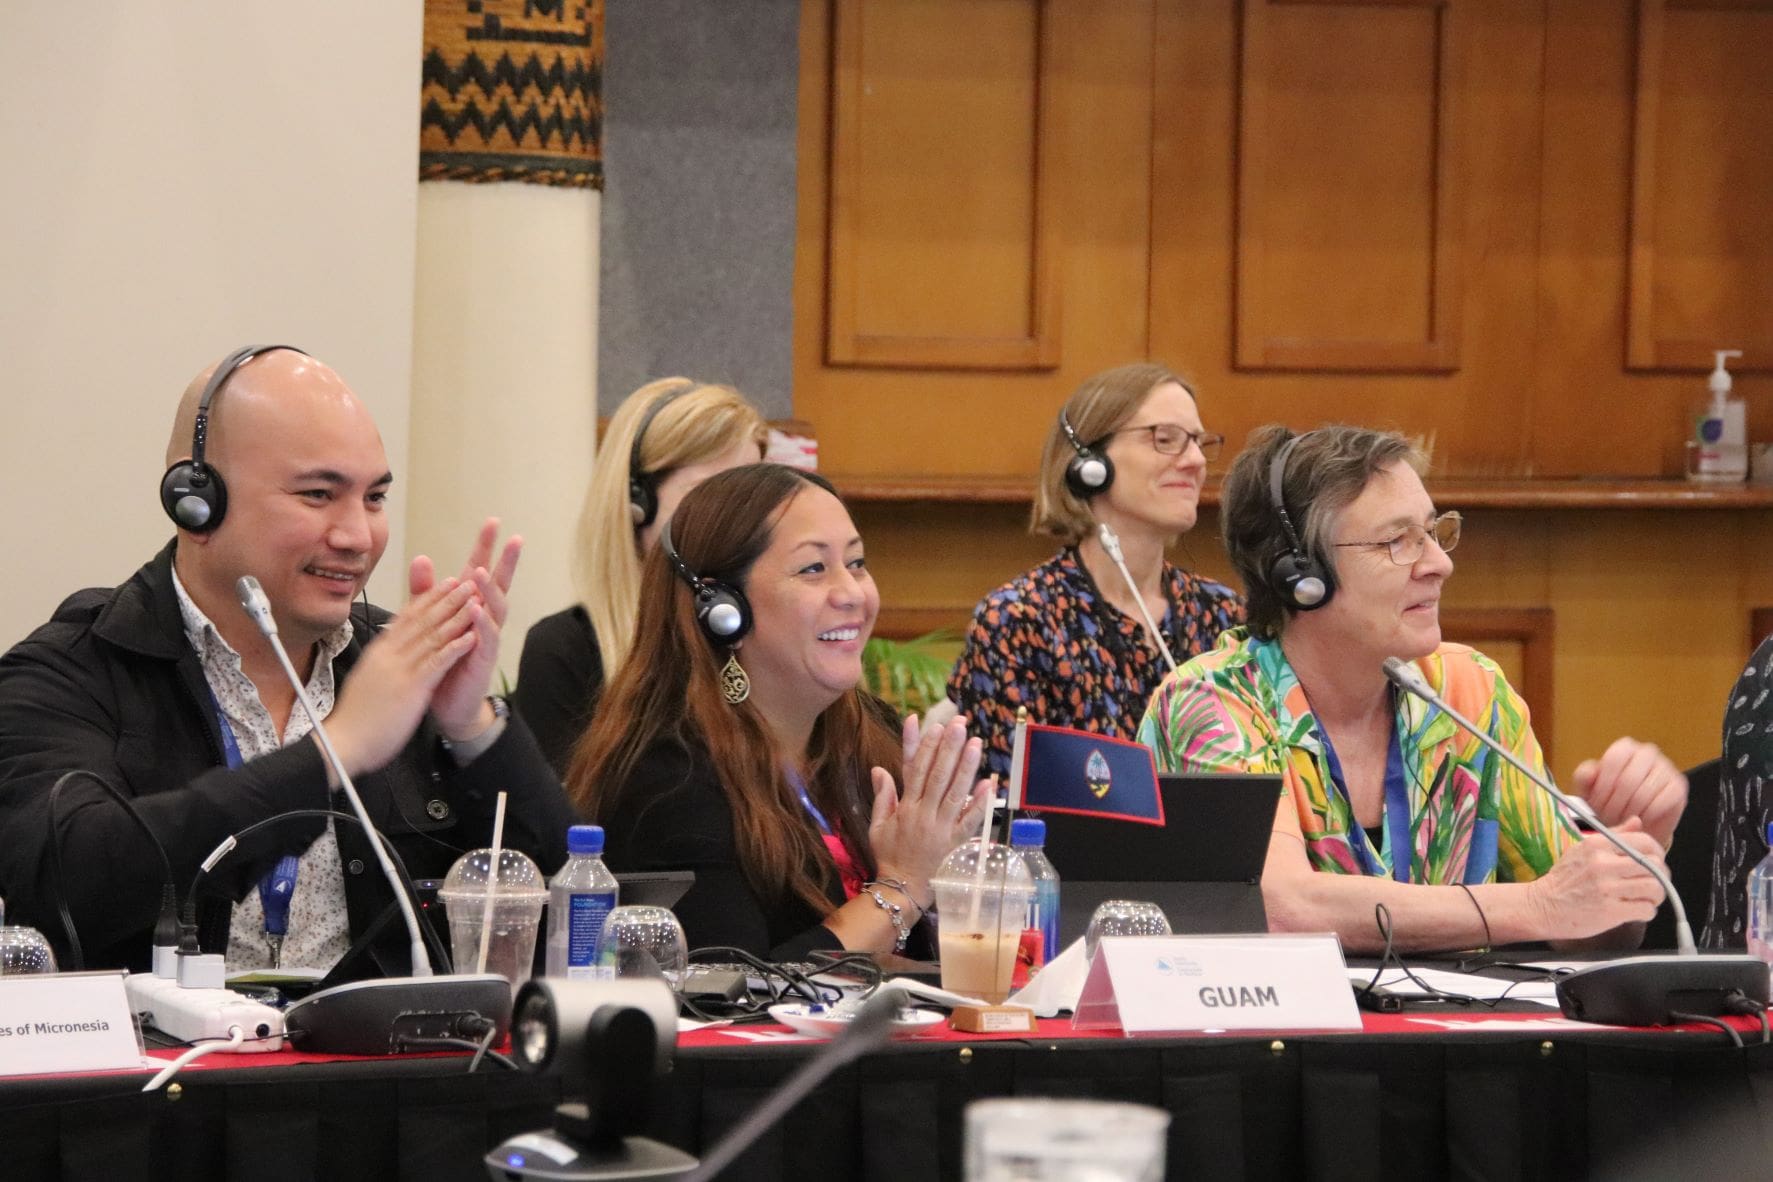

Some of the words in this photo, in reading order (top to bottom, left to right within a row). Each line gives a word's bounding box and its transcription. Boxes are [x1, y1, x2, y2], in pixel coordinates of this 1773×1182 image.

[1199, 986, 1279, 1008] GUAM
[17, 1023, 30, 1036] of
[34, 1020, 110, 1034] Micronesia
